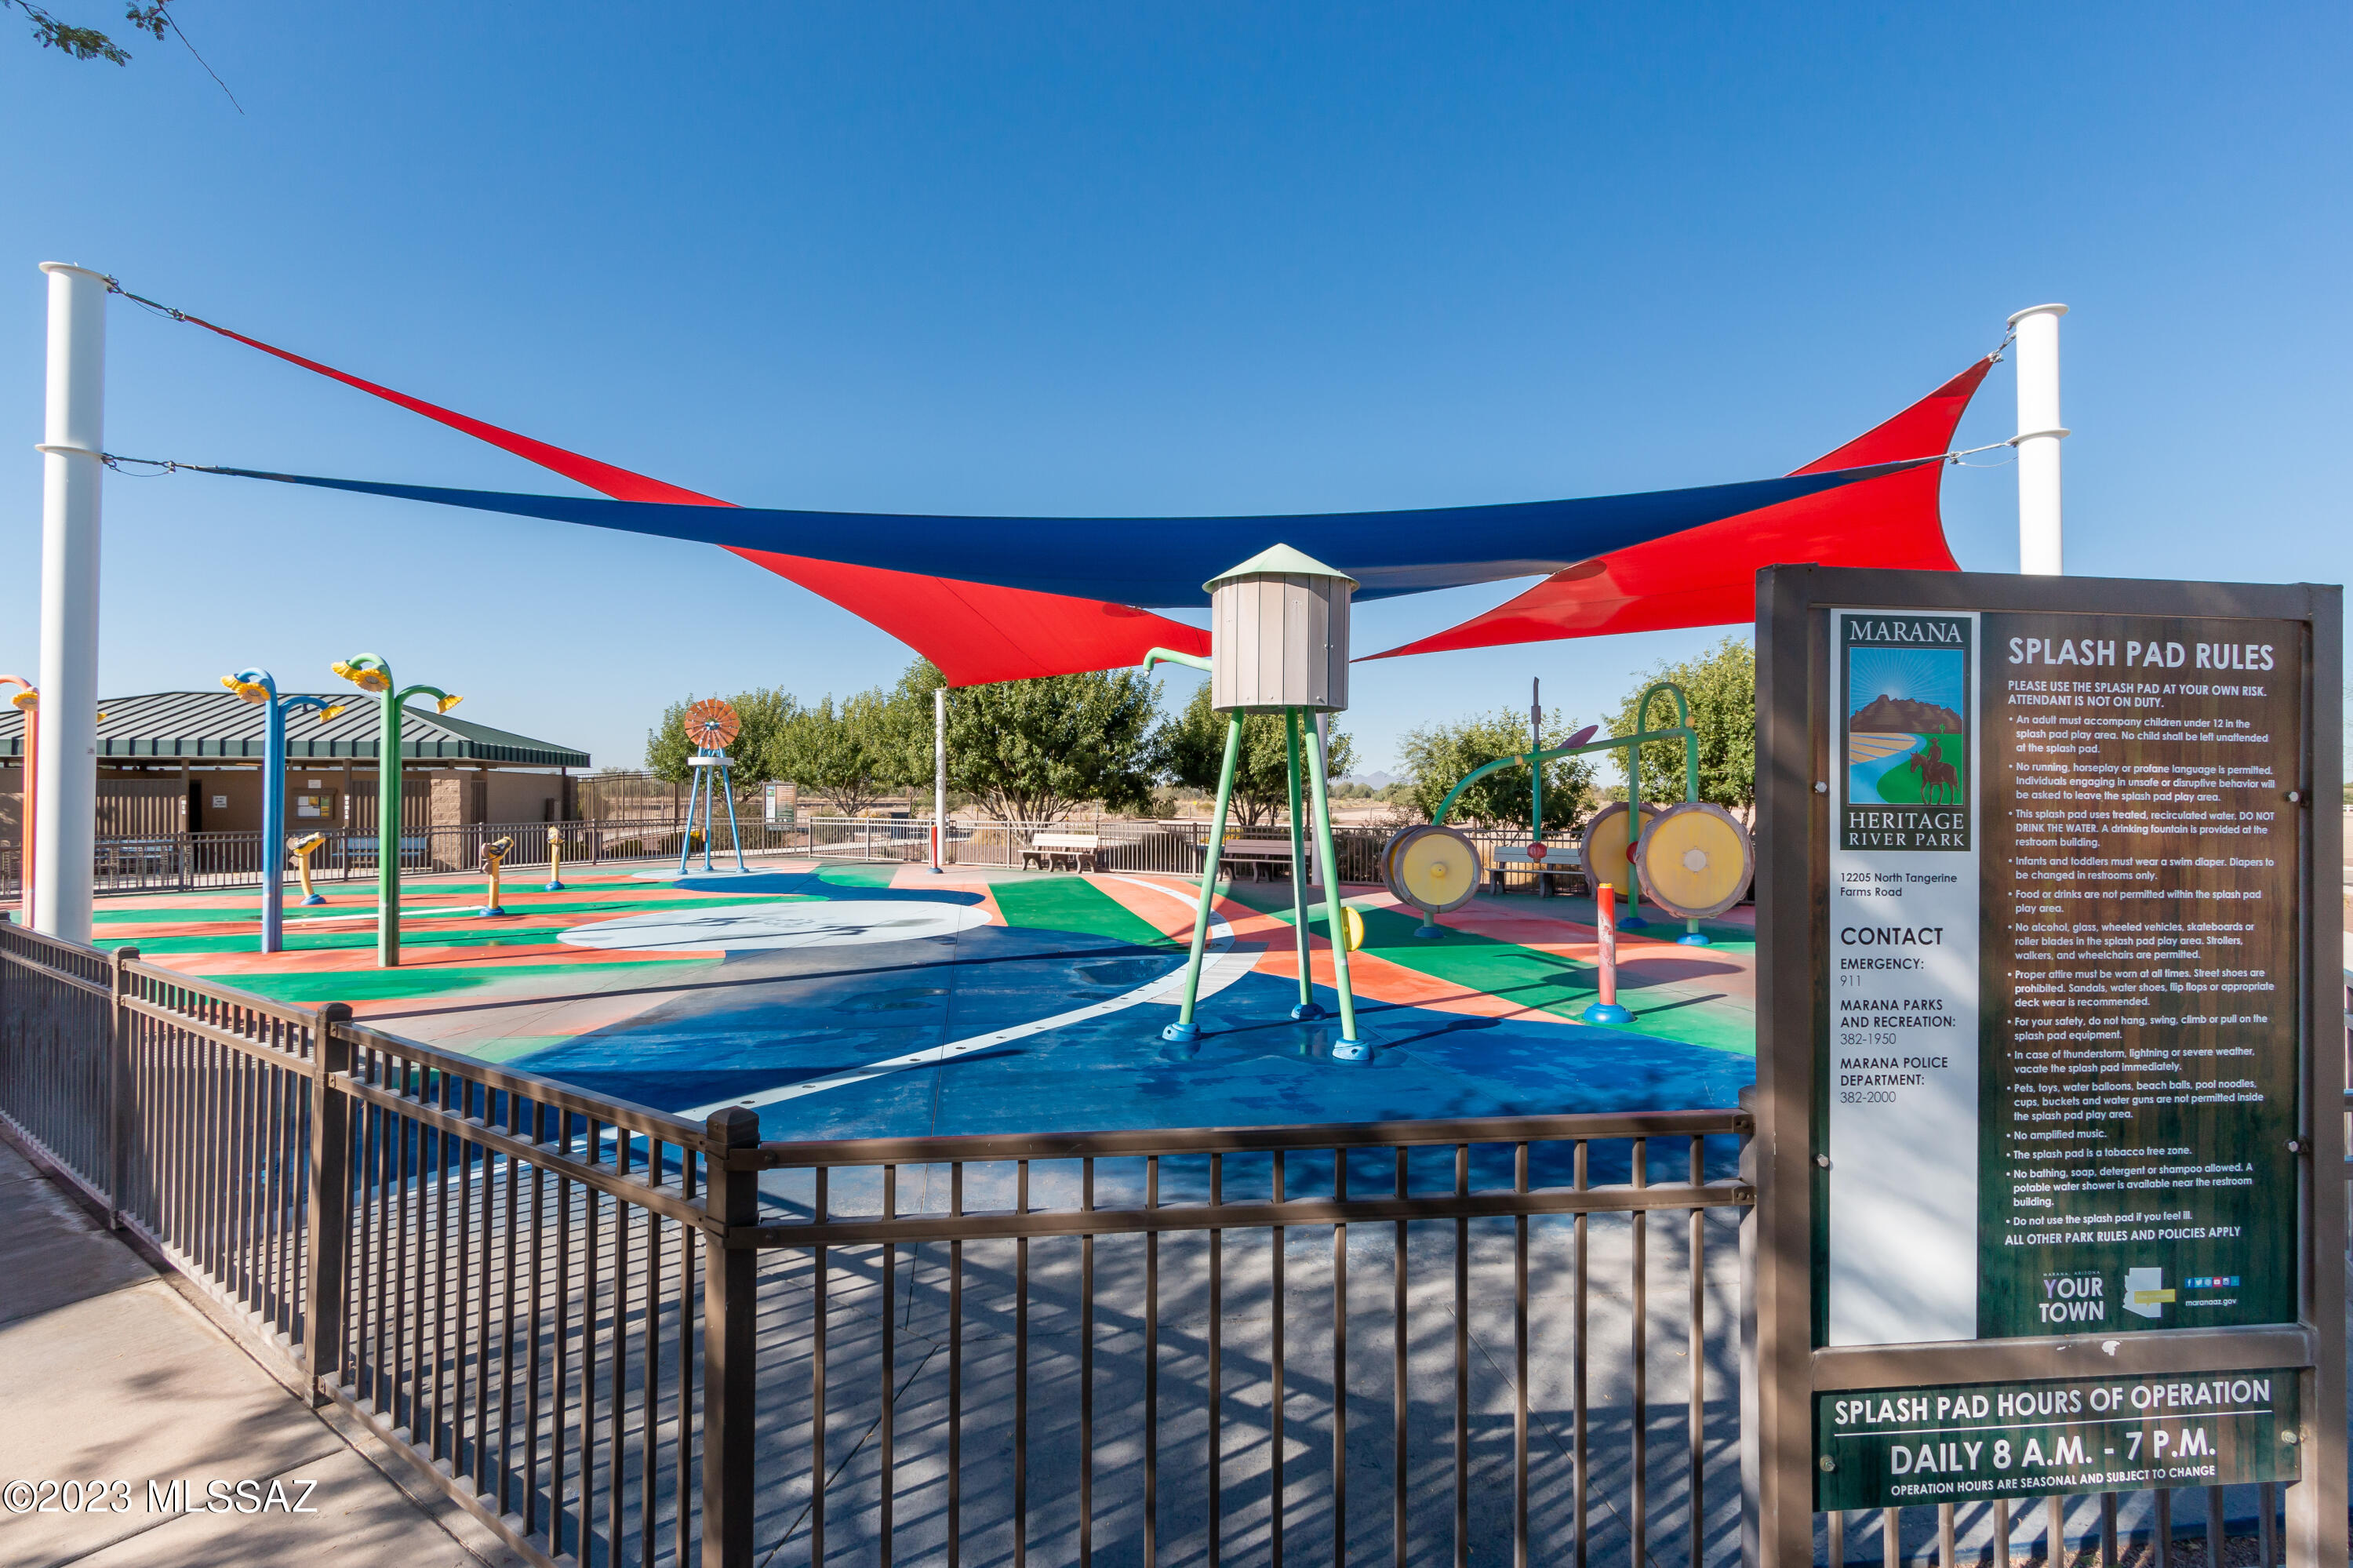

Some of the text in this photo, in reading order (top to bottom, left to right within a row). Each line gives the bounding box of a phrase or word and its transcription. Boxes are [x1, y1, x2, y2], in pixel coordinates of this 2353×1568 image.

[1849, 620, 1963, 642] MARANA
[2008, 637, 2274, 671] SPLASH PAD RULES
[2008, 679, 2047, 691] PLEASE
[2049, 681, 2070, 692] USE
[2071, 681, 2092, 693] THE
[2094, 682, 2134, 693] SPLASH
[2137, 682, 2159, 694] PAD
[2162, 683, 2177, 694] AT
[2178, 684, 2209, 695] YOUR
[2211, 684, 2239, 696] OWN
[2007, 693, 2072, 705] ATTENDANT
[2074, 695, 2084, 706] IS
[2086, 695, 2111, 707] NOT
[2112, 696, 2131, 707] ON
[2016, 715, 2250, 729] An adult must accompany children under 12 in the
[2016, 728, 2046, 740] splash
[2048, 729, 2068, 740] pad
[2070, 729, 2092, 741] play
[2121, 730, 2135, 740] No
[2137, 730, 2160, 740] child
[2162, 731, 2183, 740] shall
[2184, 731, 2198, 741] be
[2199, 732, 2214, 741] left
[2216, 733, 2268, 743] unattended
[2015, 742, 2026, 752] at
[2028, 742, 2044, 752] the
[2046, 743, 2076, 755] splash
[1848, 812, 1964, 829] HERITAGE
[1849, 832, 1964, 846] RIVER PARK
[2015, 855, 2047, 866] Infants
[2049, 856, 2068, 866] and
[2070, 856, 2108, 866] toddlers
[2110, 856, 2133, 866] must
[2169, 857, 2193, 866] swim
[2229, 857, 2264, 868] Diapers
[2264, 857, 2275, 867] to
[1841, 872, 1957, 885] 12205 North Tangerine
[2015, 870, 2029, 879] be
[2031, 870, 2075, 882] changed
[2076, 870, 2086, 879] in
[2087, 870, 2133, 880] restrooms
[1840, 886, 1902, 897] Farms Road
[1840, 926, 1943, 945] CONTACT
[1840, 958, 1924, 970] EMERGENCY:
[1839, 974, 1860, 987] 911
[1840, 999, 1943, 1011] MARANA PARKS
[1840, 1015, 1955, 1028] AND RECREATION:
[2014, 1017, 2029, 1026] For
[2031, 1018, 2053, 1028] your
[2088, 1016, 2101, 1025] do
[2103, 1015, 2119, 1025] not
[2180, 1014, 2207, 1024] climb
[2220, 1013, 2237, 1025] pull
[2253, 1013, 2268, 1023] the
[1840, 1032, 1897, 1045] 382-1950
[2014, 1031, 2045, 1042] splash
[2046, 1030, 2067, 1042] pad
[2014, 1050, 2023, 1060] In
[2025, 1051, 2049, 1060] case
[2051, 1049, 2061, 1059] of
[2129, 1047, 2169, 1060] lightning
[2182, 1048, 2213, 1057] severe
[1840, 1057, 1947, 1069] MARANA POLICE
[2013, 1064, 2049, 1073] vacate
[2049, 1063, 2066, 1073] the
[2068, 1062, 2098, 1074] splash
[2100, 1062, 2119, 1074] pad
[1840, 1074, 1924, 1086] DEPARTMENT:
[1839, 1090, 1897, 1104] 382-2000
[2013, 1130, 2028, 1140] No
[2029, 1129, 2075, 1141] amplified
[2013, 1217, 2027, 1226] Do
[2028, 1215, 2045, 1225] not
[2064, 1214, 2081, 1224] the
[2082, 1213, 2113, 1225] splash
[2114, 1212, 2134, 1224] pad
[2136, 1212, 2142, 1221] if
[2143, 1213, 2162, 1223] you
[2162, 1210, 2181, 1221] feel
[2004, 1225, 2240, 1246] ALL OTHER PARK RULES AND POLICIES APPLY
[2042, 1276, 2104, 1299] YOUR
[2184, 1298, 2237, 1307] maranaaz.gov
[2038, 1300, 2104, 1322] TOWN
[1834, 1378, 2269, 1425] SPLASH PAD HOURS OF OPERATION
[1891, 1440, 1983, 1475] DAILY
[1992, 1439, 2013, 1469] 8
[2126, 1431, 2143, 1461] 7
[1890, 1464, 2215, 1496] OPERATION HOURS ARE SEASONAL AND SUBJECT TO CHANGE
